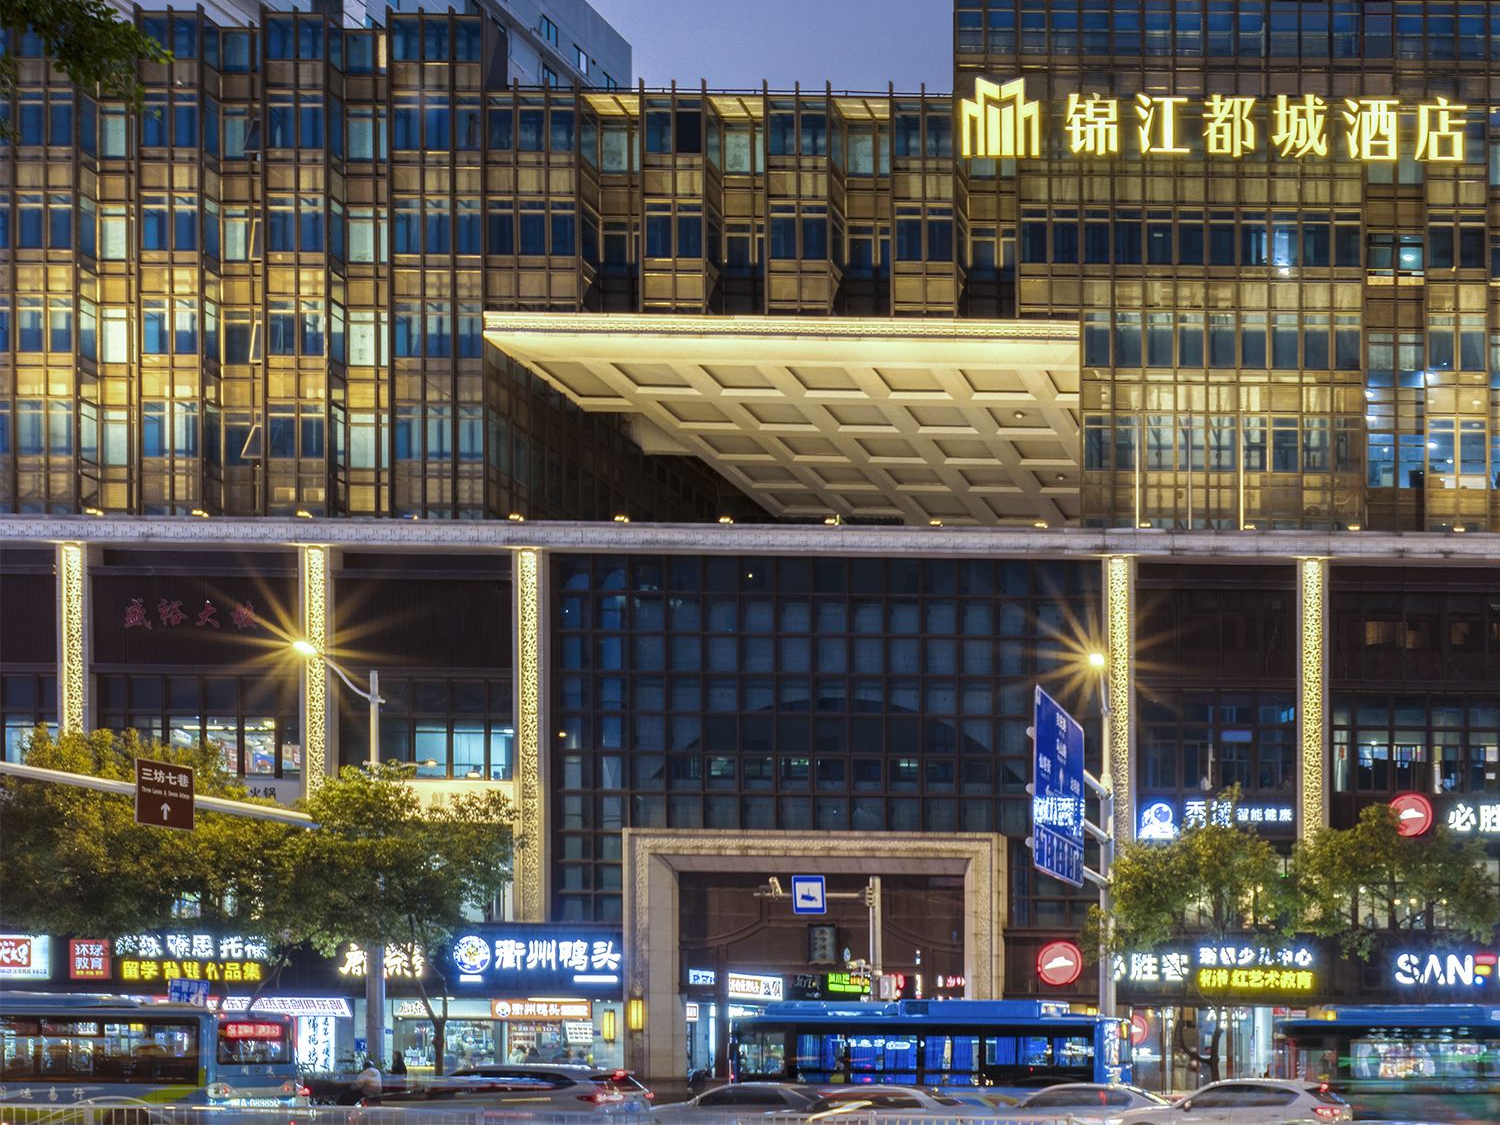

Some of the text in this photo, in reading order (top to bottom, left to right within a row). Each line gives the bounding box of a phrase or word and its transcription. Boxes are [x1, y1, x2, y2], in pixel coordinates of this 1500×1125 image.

[1065, 92, 1468, 162] 锦江都城酒店
[141, 768, 189, 787] 三坊七巷
[1236, 808, 1293, 821] 智能健康
[75, 944, 103, 956] 环球
[495, 939, 621, 970] 衢州鸭头
[75, 957, 103, 970] 教育
[512, 1003, 560, 1016] 衢州鸭头
